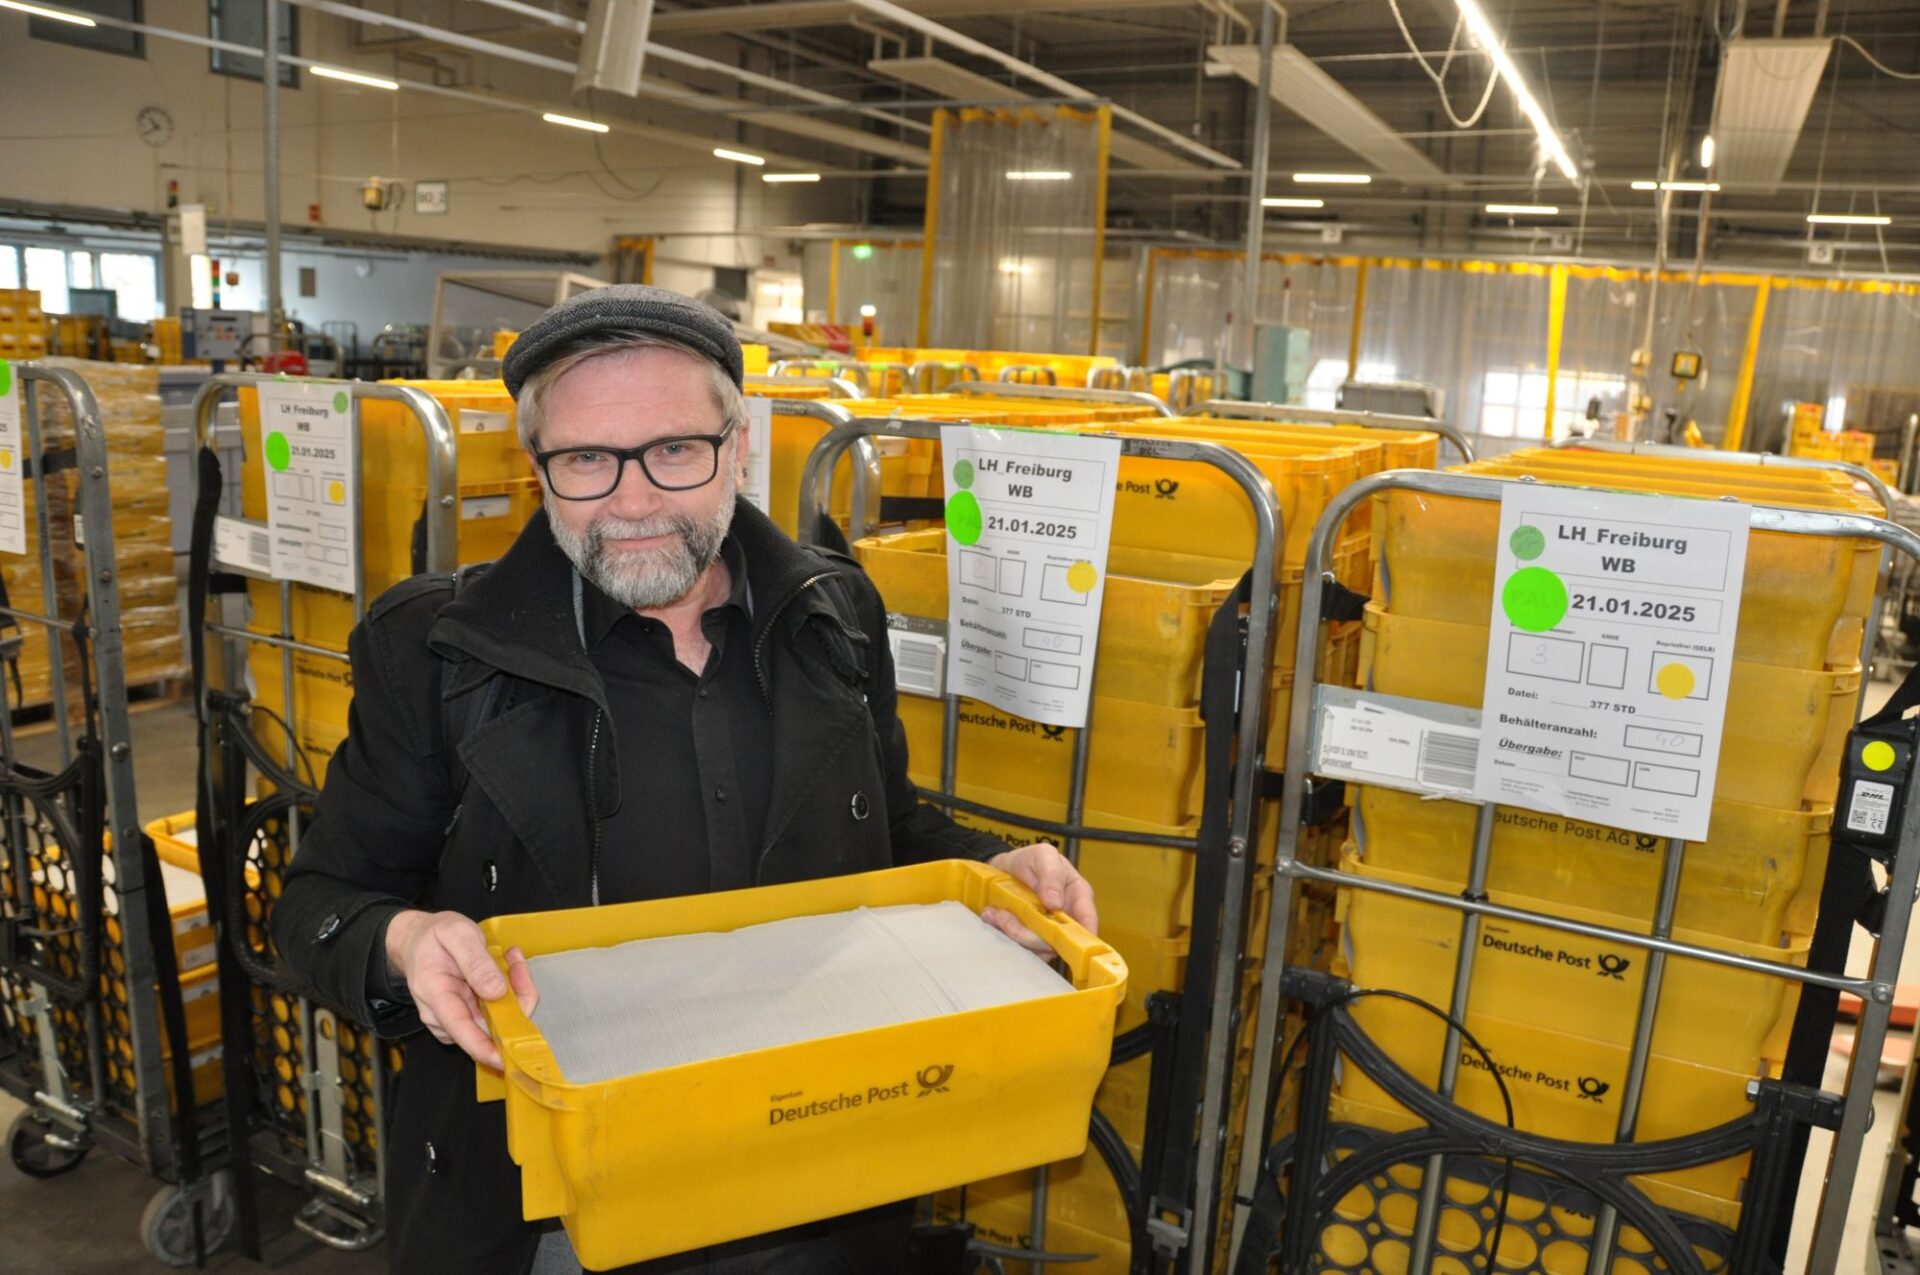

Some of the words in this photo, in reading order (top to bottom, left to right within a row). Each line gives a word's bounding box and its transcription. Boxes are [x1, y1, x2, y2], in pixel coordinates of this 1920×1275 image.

[296, 421, 311, 432] WB
[978, 458, 1072, 482] LH_Freiburg
[1008, 483, 1033, 498] WB
[1126, 480, 1151, 494] Post
[988, 516, 1077, 539] 21.01.2025
[1558, 525, 1688, 555] LH_Freiburg
[1601, 556, 1636, 573] WB
[1016, 608, 1031, 619] STD
[1572, 594, 1696, 622] 21.01.2025
[1507, 686, 1538, 700] Datei:
[1590, 700, 1610, 711] 377
[1612, 703, 1637, 715] STD
[959, 712, 1007, 729] eutsche
[1009, 718, 1037, 734] Post
[1499, 713, 1598, 740] Behälteranzahl:
[1498, 737, 1564, 760] Übergabe:
[1495, 810, 1559, 832] eutsche
[1564, 821, 1601, 841] Post
[1606, 831, 1631, 846] AG
[1482, 934, 1554, 961] Deutsche
[1557, 950, 1592, 970] Post
[1460, 1053, 1532, 1082] Deusche
[1536, 1071, 1571, 1092] Post
[769, 1093, 862, 1126] Deutsche
[867, 1080, 910, 1104] Post
